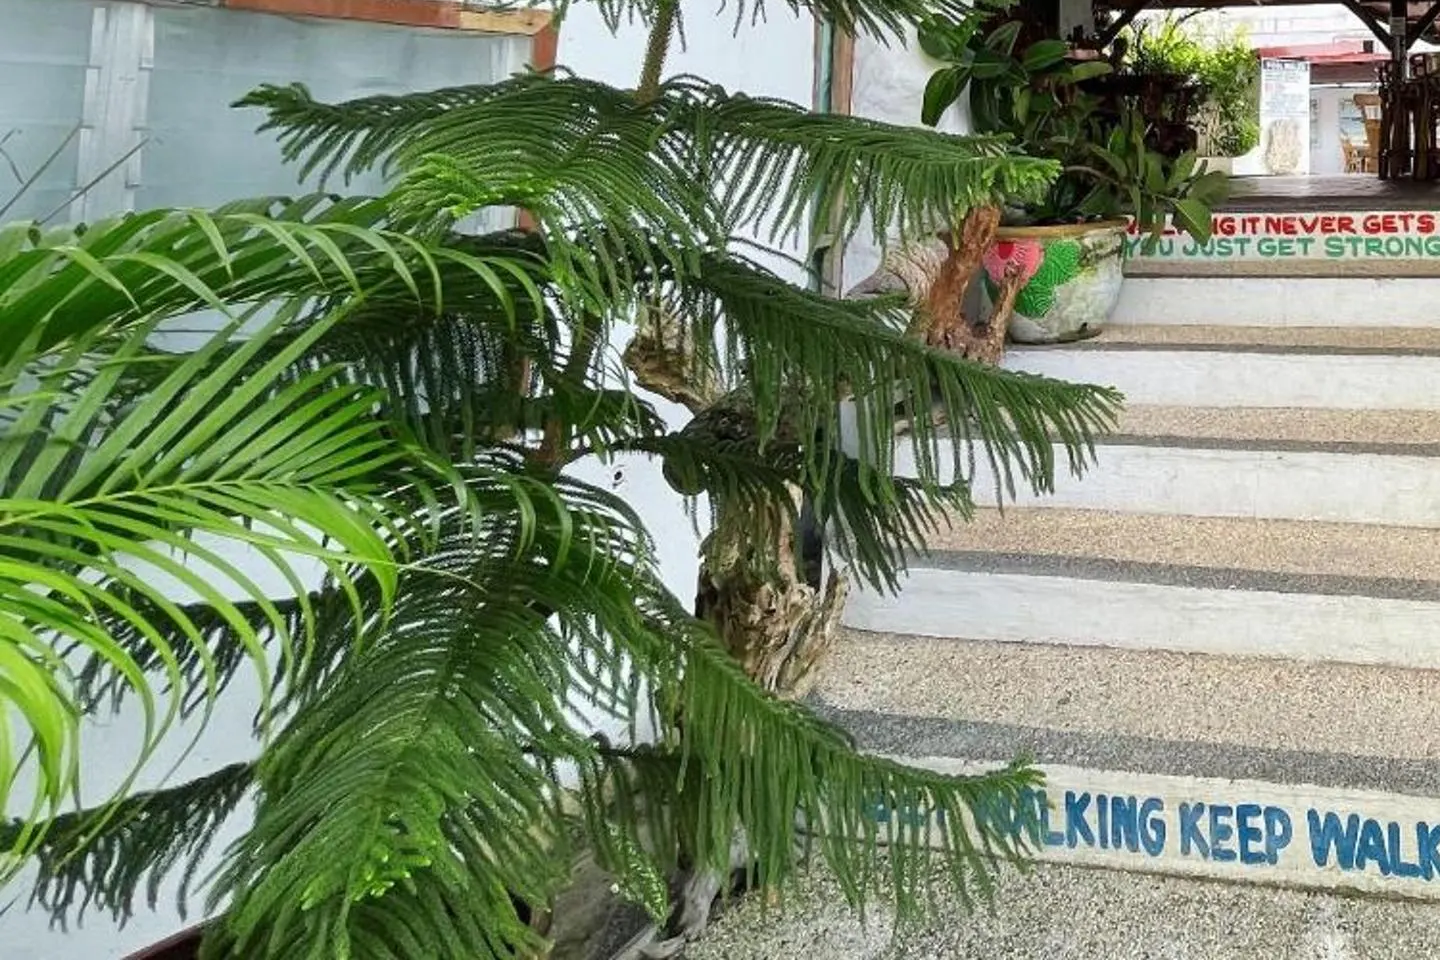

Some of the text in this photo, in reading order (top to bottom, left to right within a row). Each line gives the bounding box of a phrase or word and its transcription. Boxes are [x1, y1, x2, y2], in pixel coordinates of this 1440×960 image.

[1241, 216, 1261, 234] IT
[1264, 215, 1354, 235] NEVER
[1362, 214, 1435, 234] GETS
[1182, 237, 1252, 258] JUST
[1257, 237, 1316, 257] GET
[1178, 801, 1293, 865] KEEP
